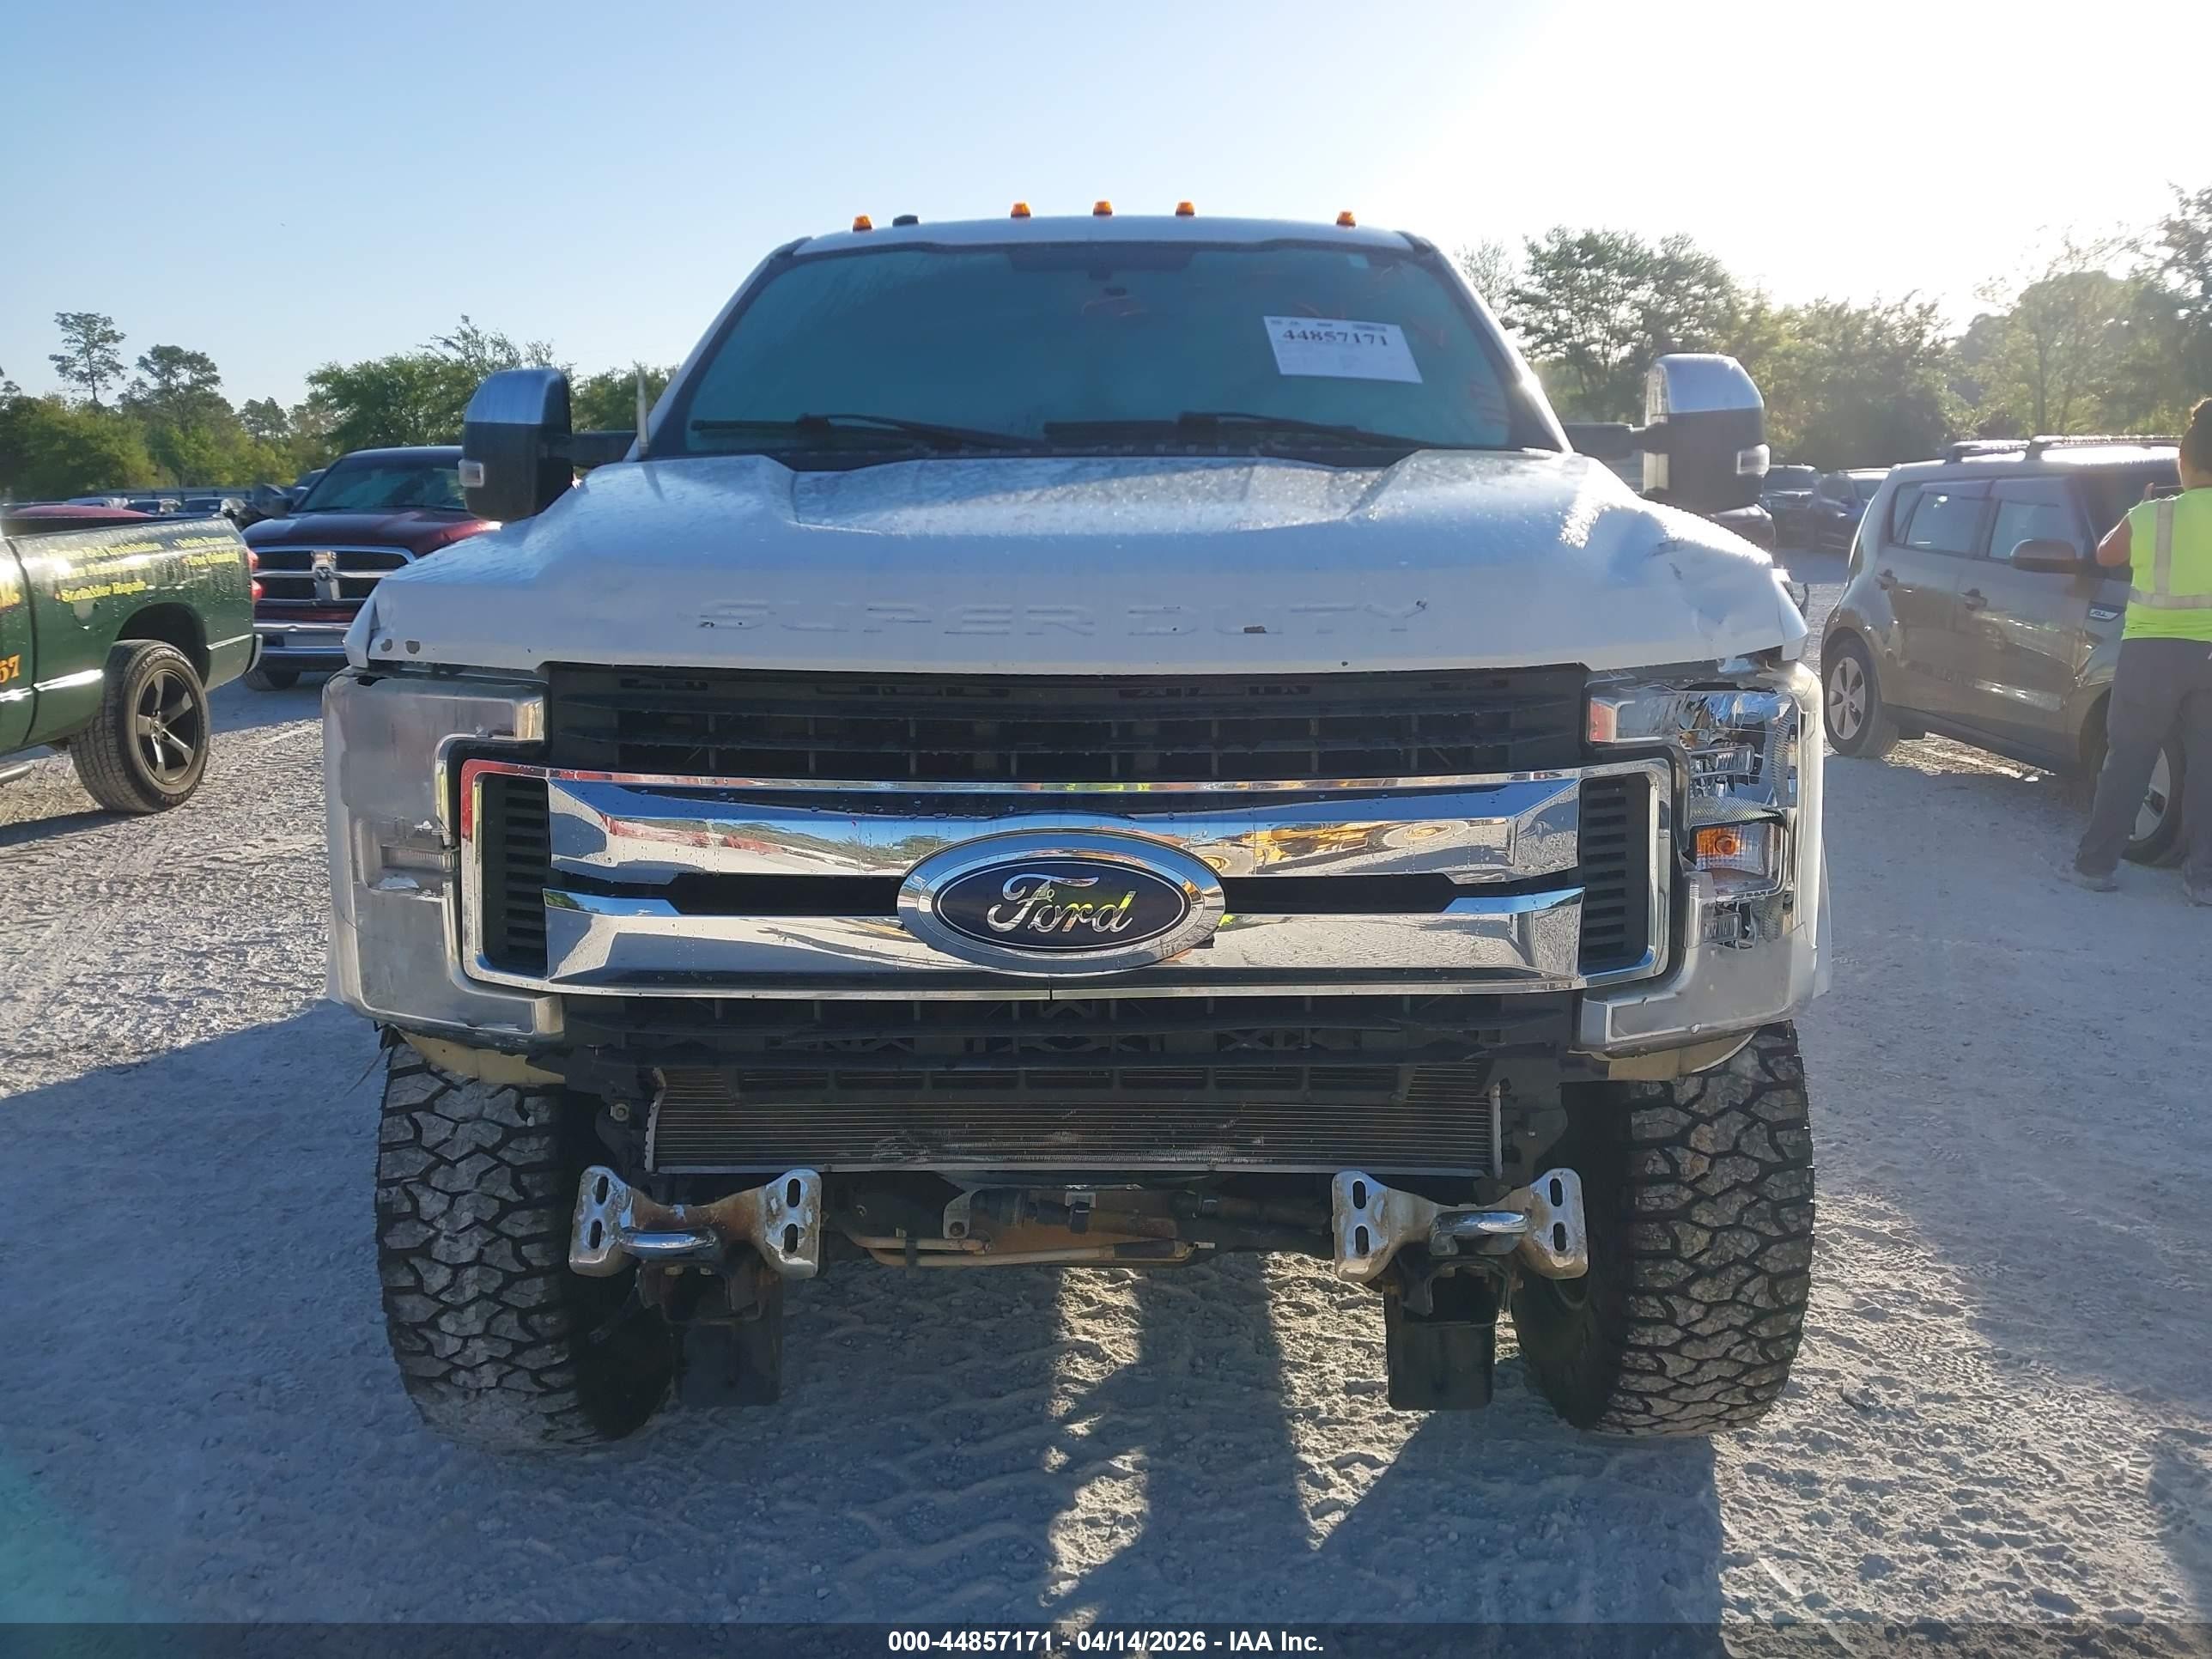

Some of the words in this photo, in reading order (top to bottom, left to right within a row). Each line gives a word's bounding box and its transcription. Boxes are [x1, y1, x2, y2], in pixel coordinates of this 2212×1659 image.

[1283, 329, 1388, 346] 44857171
[698, 599, 1095, 636] SUPER
[1127, 599, 1428, 636] DUTY
[987, 872, 1138, 933] Ford
